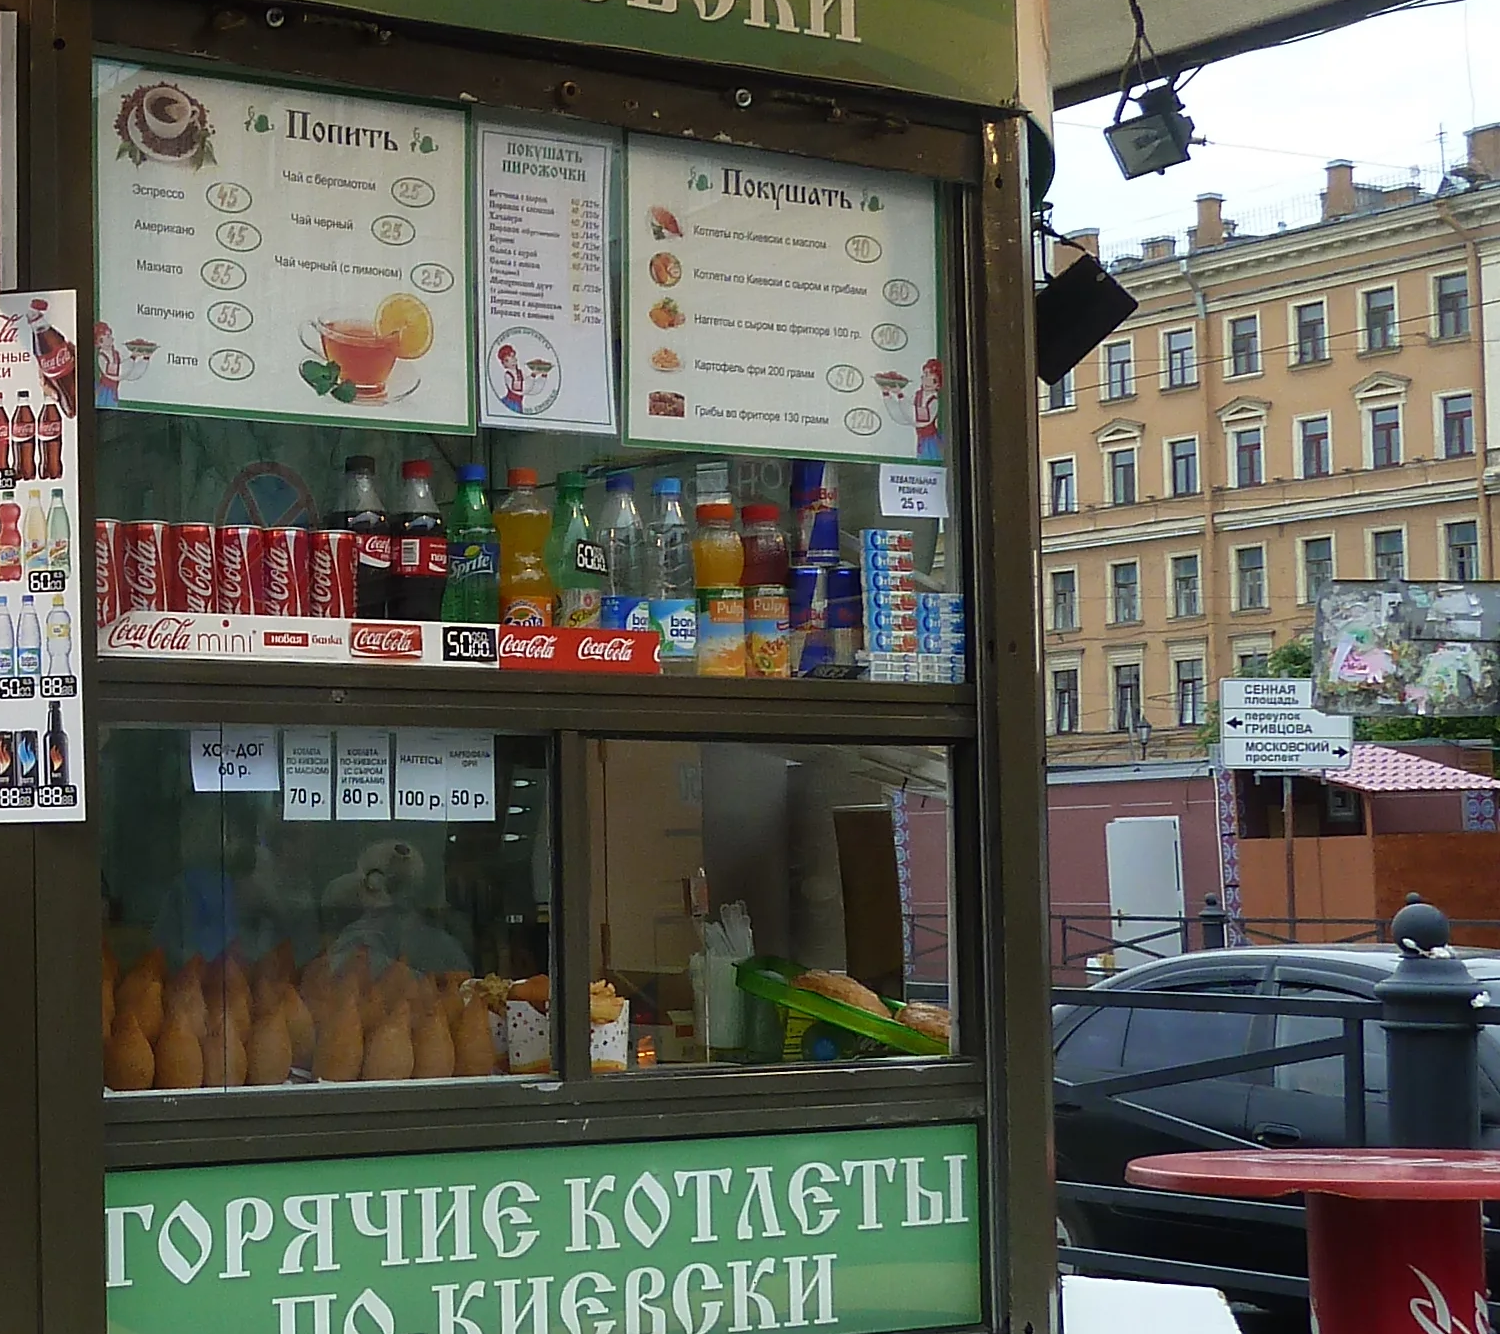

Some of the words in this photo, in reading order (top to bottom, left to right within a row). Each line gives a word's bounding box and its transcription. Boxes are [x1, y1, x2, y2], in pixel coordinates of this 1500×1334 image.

[285, 109, 399, 152] Попить
[507, 142, 583, 163] ПОКУШАТЬ
[282, 170, 304, 183] Чай
[306, 175, 313, 184] с
[502, 160, 587, 183] ПИРОЖОЧКИ
[132, 183, 185, 201] Эспрессо
[217, 183, 239, 207] 45
[399, 182, 422, 200] 25
[721, 167, 853, 211] Покушать
[134, 218, 195, 236] Американо
[291, 213, 312, 226] Чай
[314, 216, 353, 231] черный
[381, 221, 402, 240] 25
[275, 255, 296, 268] Чай
[421, 269, 444, 288] 25
[137, 303, 195, 321] Каппучино
[217, 306, 240, 328] 55
[167, 353, 199, 367] Латте
[220, 353, 243, 375] 55
[901, 498, 914, 509] 25
[108, 616, 196, 651] Coca-Cola
[197, 619, 253, 653] mini
[270, 634, 302, 645] новая
[312, 634, 343, 646] банка
[353, 628, 414, 652] Coca-Cola
[500, 633, 558, 659] Coca-Cola
[578, 636, 636, 662] Coca-Cola
[1244, 684, 1296, 695] СЕННАЯ
[1244, 697, 1299, 705] площадь
[1245, 712, 1301, 722] переулок
[1245, 724, 1313, 735] ГРИВЦОВА
[1245, 740, 1330, 752] МОСКОВСКИЙ
[1245, 754, 1301, 763] проспект
[290, 788, 307, 805] 70
[342, 788, 362, 805] 80
[398, 790, 424, 806] 100
[451, 790, 469, 806] 50
[105, 1180, 539, 1287] ГОРЯЧИЕ
[564, 1155, 969, 1253] КОТЛЕТЫ
